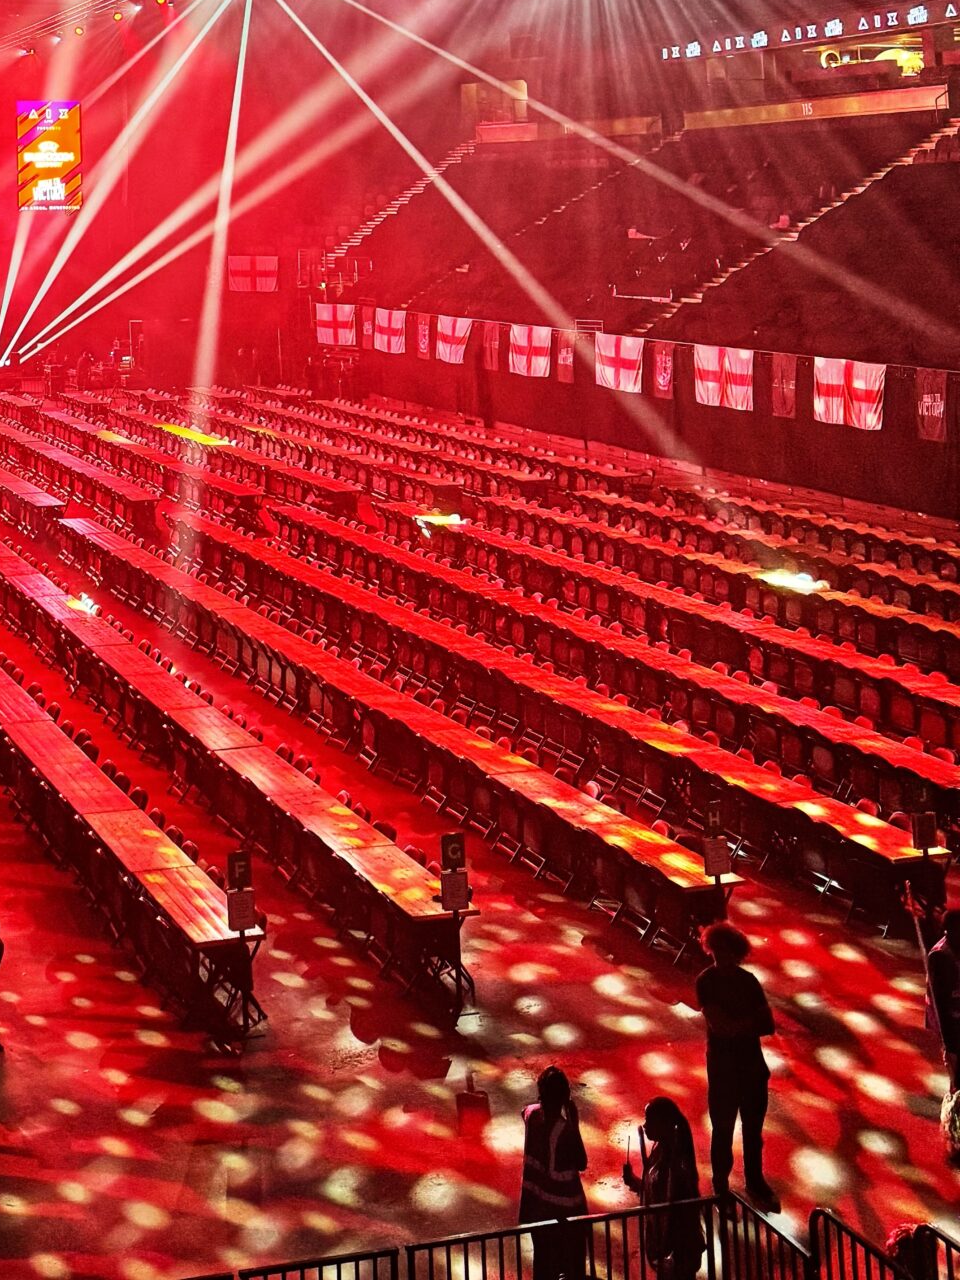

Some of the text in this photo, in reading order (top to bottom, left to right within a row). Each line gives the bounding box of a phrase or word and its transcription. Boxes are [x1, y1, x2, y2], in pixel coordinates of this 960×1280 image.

[801, 103, 813, 116] 115
[918, 400, 944, 418] VICTORY
[708, 810, 721, 826] H
[448, 842, 461, 859] G
[235, 861, 246, 878] F
